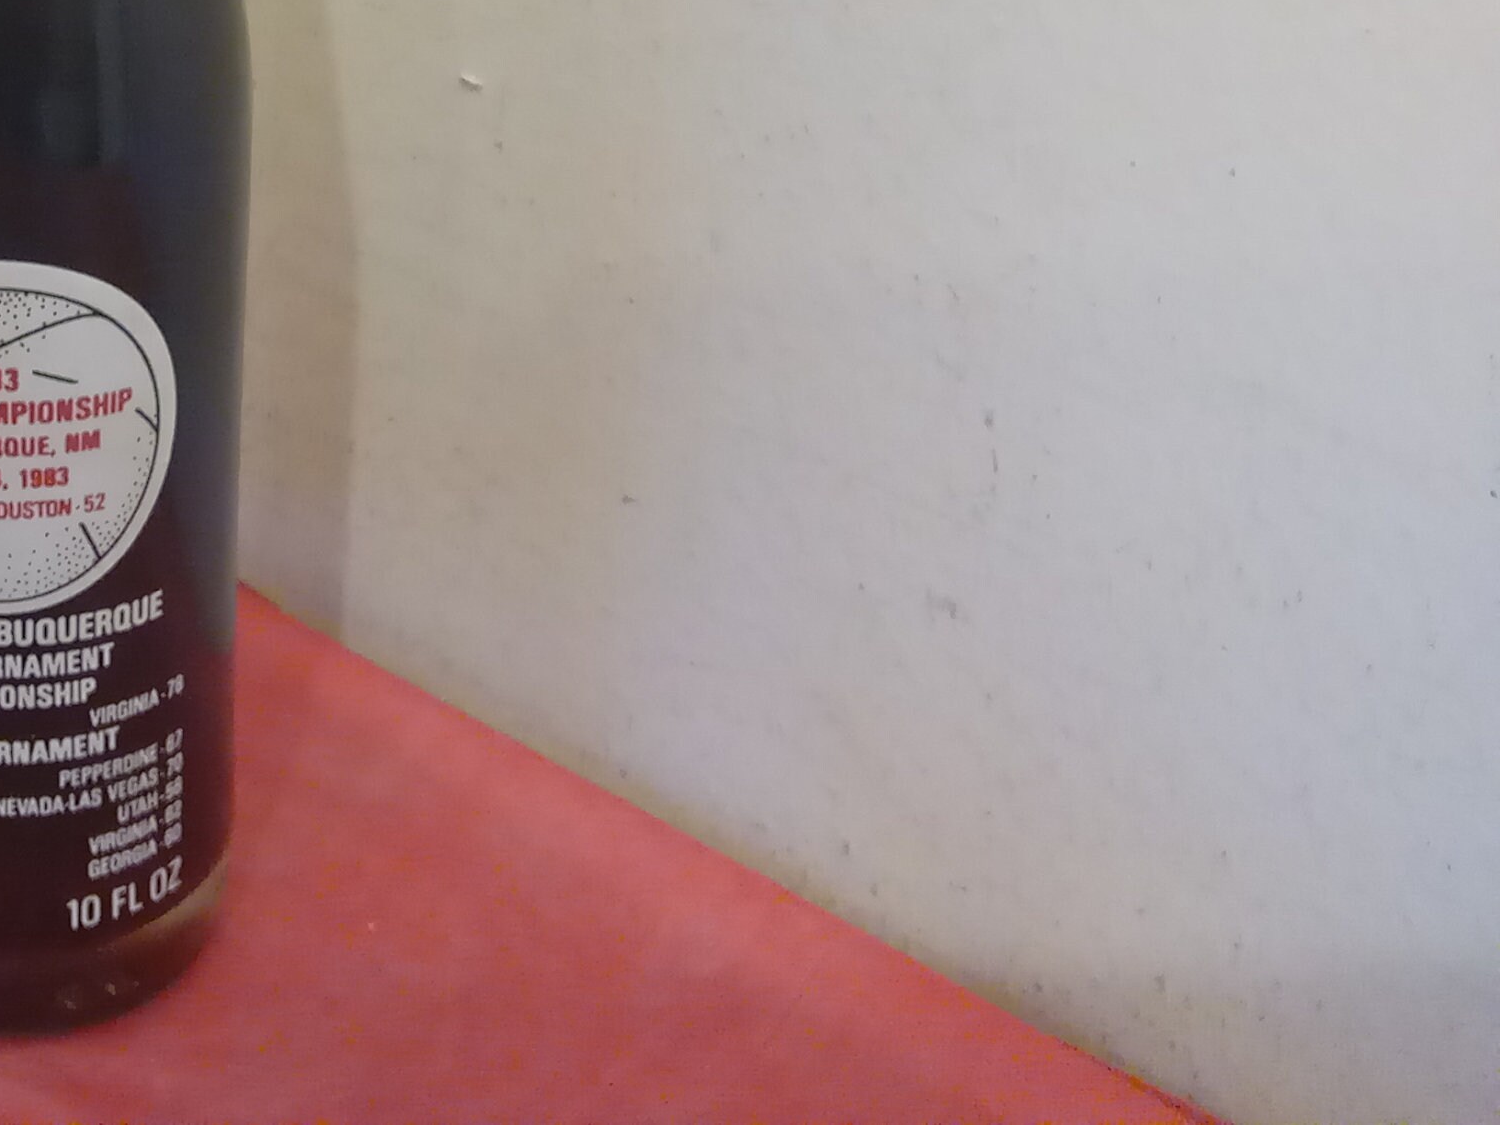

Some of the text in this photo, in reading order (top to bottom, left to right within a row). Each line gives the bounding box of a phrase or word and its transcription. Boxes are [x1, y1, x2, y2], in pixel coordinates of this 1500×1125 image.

[65, 429, 101, 454] NM
[19, 466, 70, 489] 1983
[66, 855, 183, 931] 10 FL OZ
